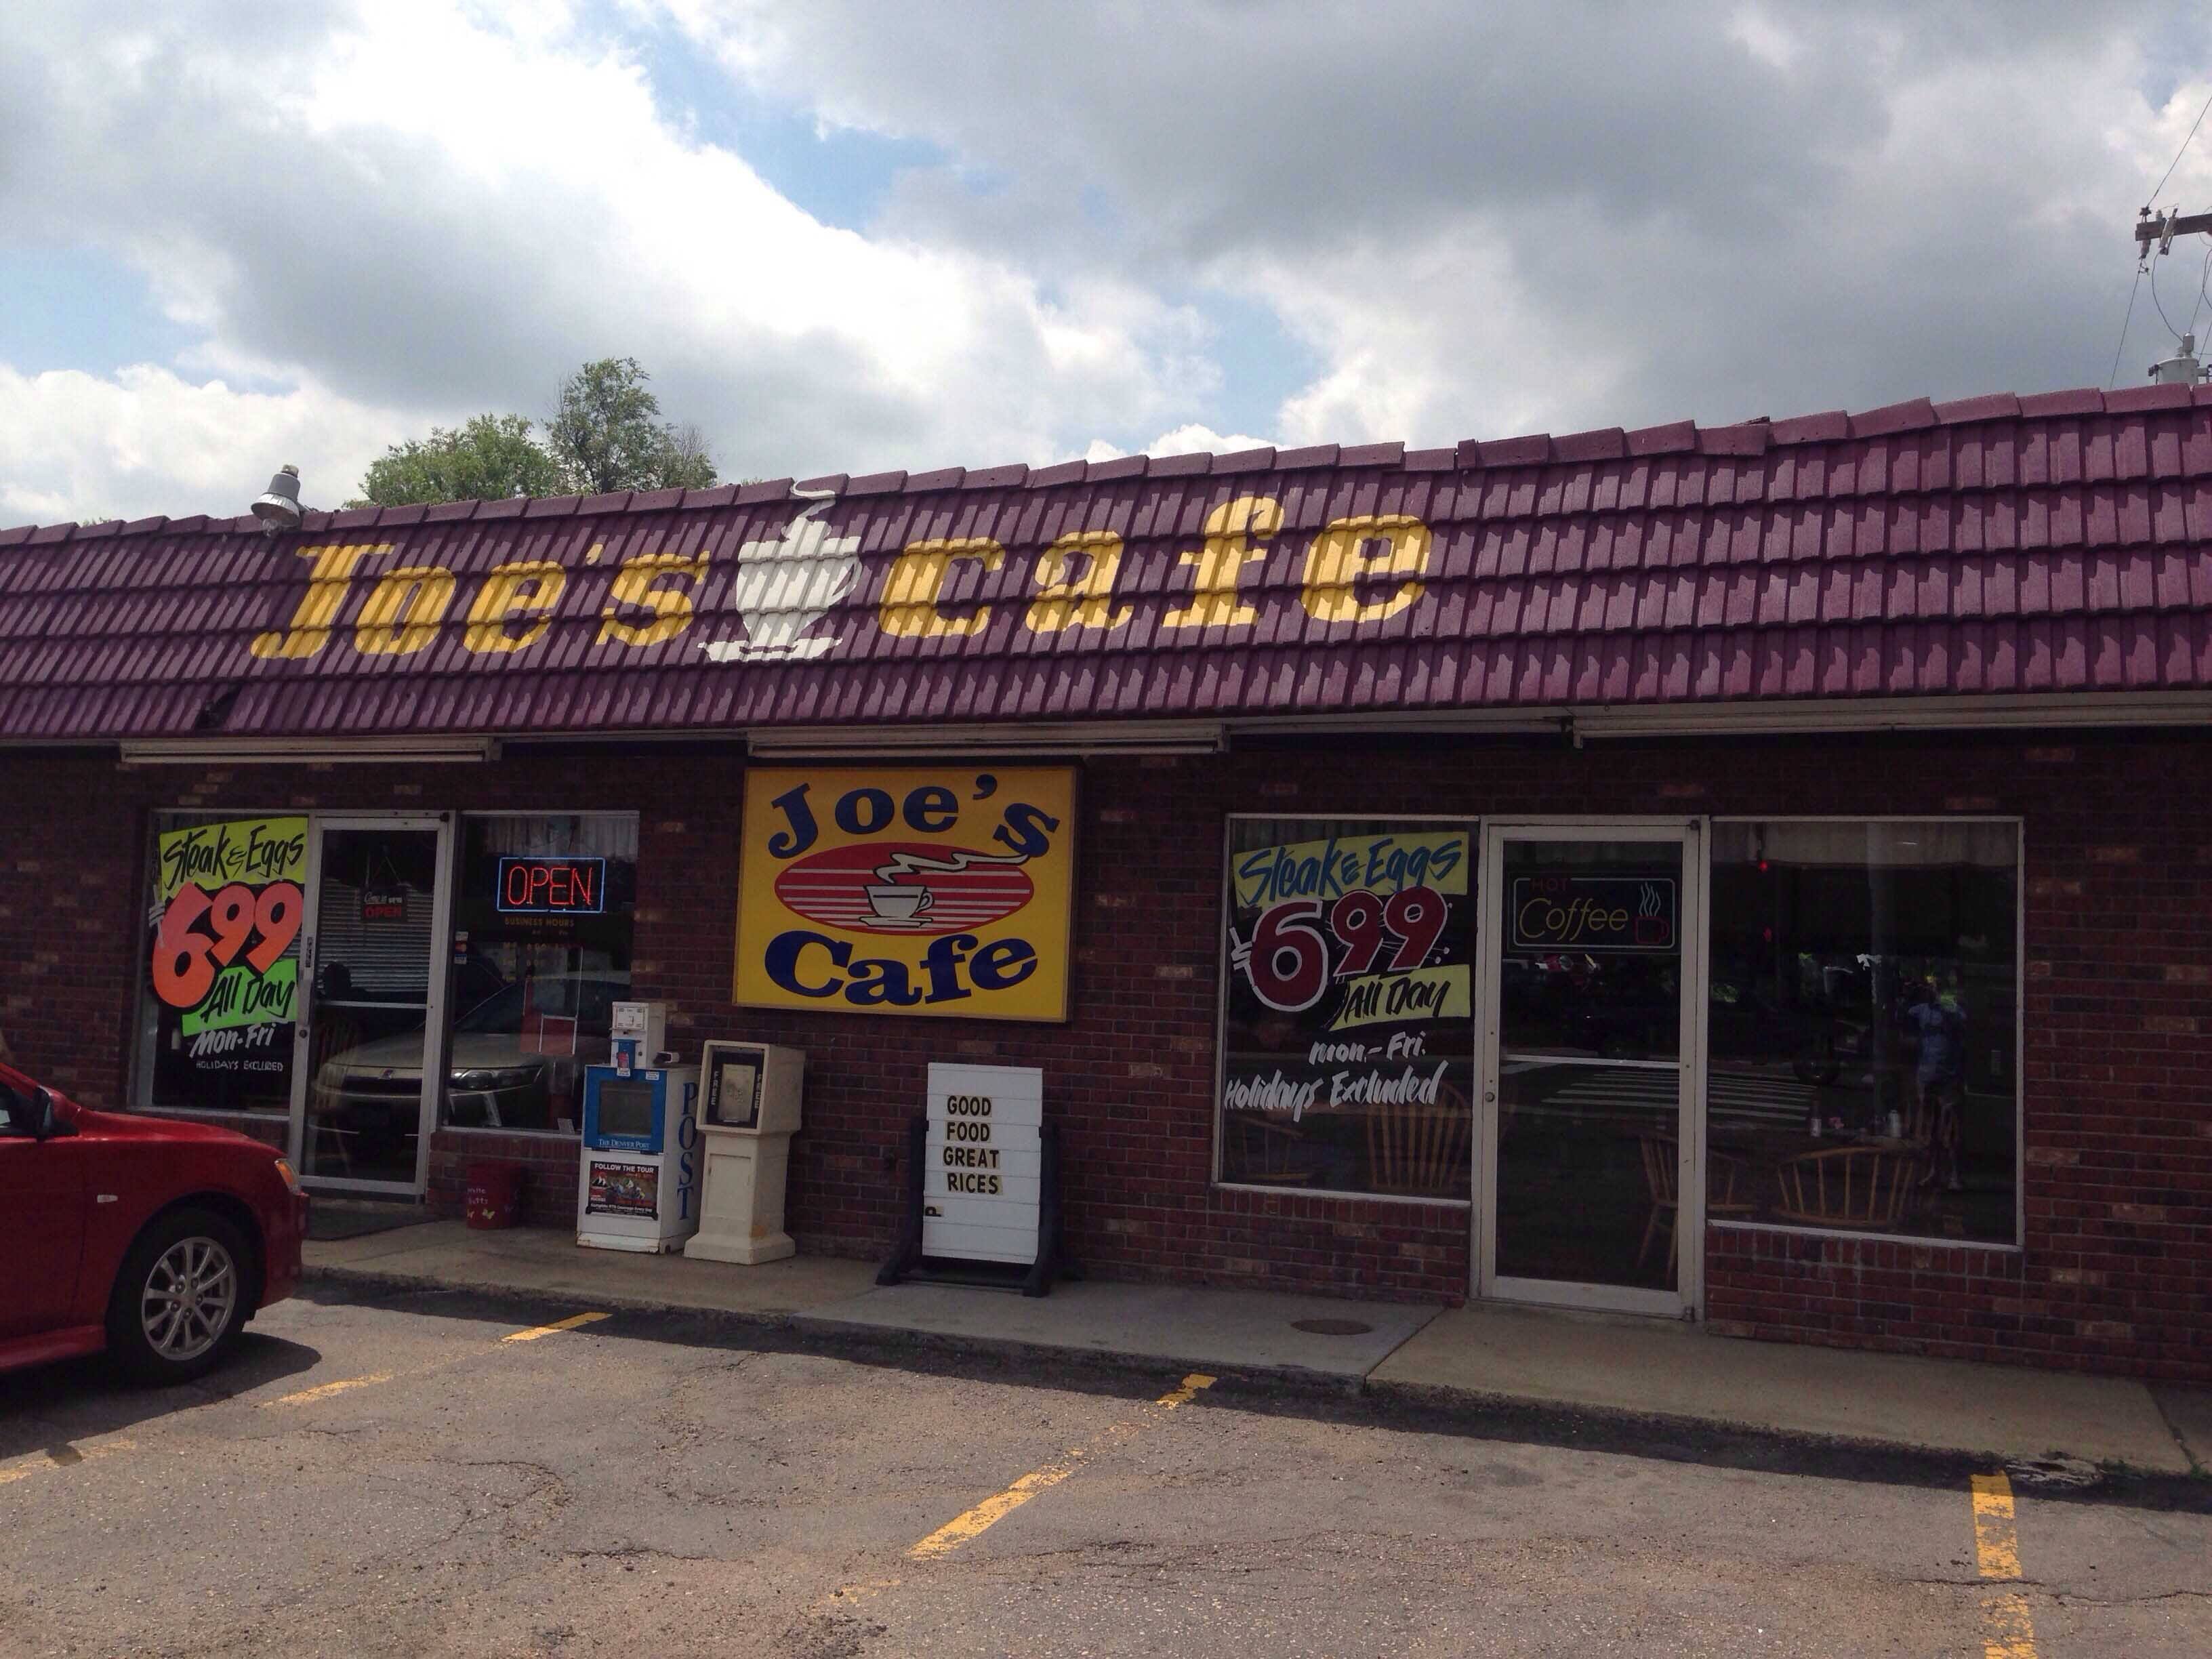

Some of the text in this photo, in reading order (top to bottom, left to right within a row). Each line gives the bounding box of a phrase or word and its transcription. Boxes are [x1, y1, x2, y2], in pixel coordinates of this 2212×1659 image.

[249, 495, 1433, 660] Joe's cafe
[768, 773, 1061, 859] Joe's
[163, 825, 230, 890] Steak
[246, 825, 304, 878] Eggs
[1239, 838, 1342, 905] Steak
[1363, 838, 1464, 893] Eggs
[507, 865, 593, 906] OPEN
[365, 906, 402, 918] OPEN
[546, 917, 575, 927] HOURS
[1519, 897, 1629, 943] Coffee
[764, 930, 1038, 1007] Cafe
[201, 972, 295, 1023] All Day
[1344, 977, 1451, 1024] All Day
[197, 1061, 283, 1072] HOLIDAYS EXCLUDED
[947, 1095, 991, 1116] GOOD
[1224, 1059, 1449, 1122] Holidays Excluded
[611, 1139, 634, 1147] DENVER
[678, 1082, 696, 1219] POST
[947, 1122, 989, 1141] FOOD
[943, 1146, 999, 1168] GREAT
[947, 1172, 998, 1194] RICES
[925, 1206, 942, 1217] P
